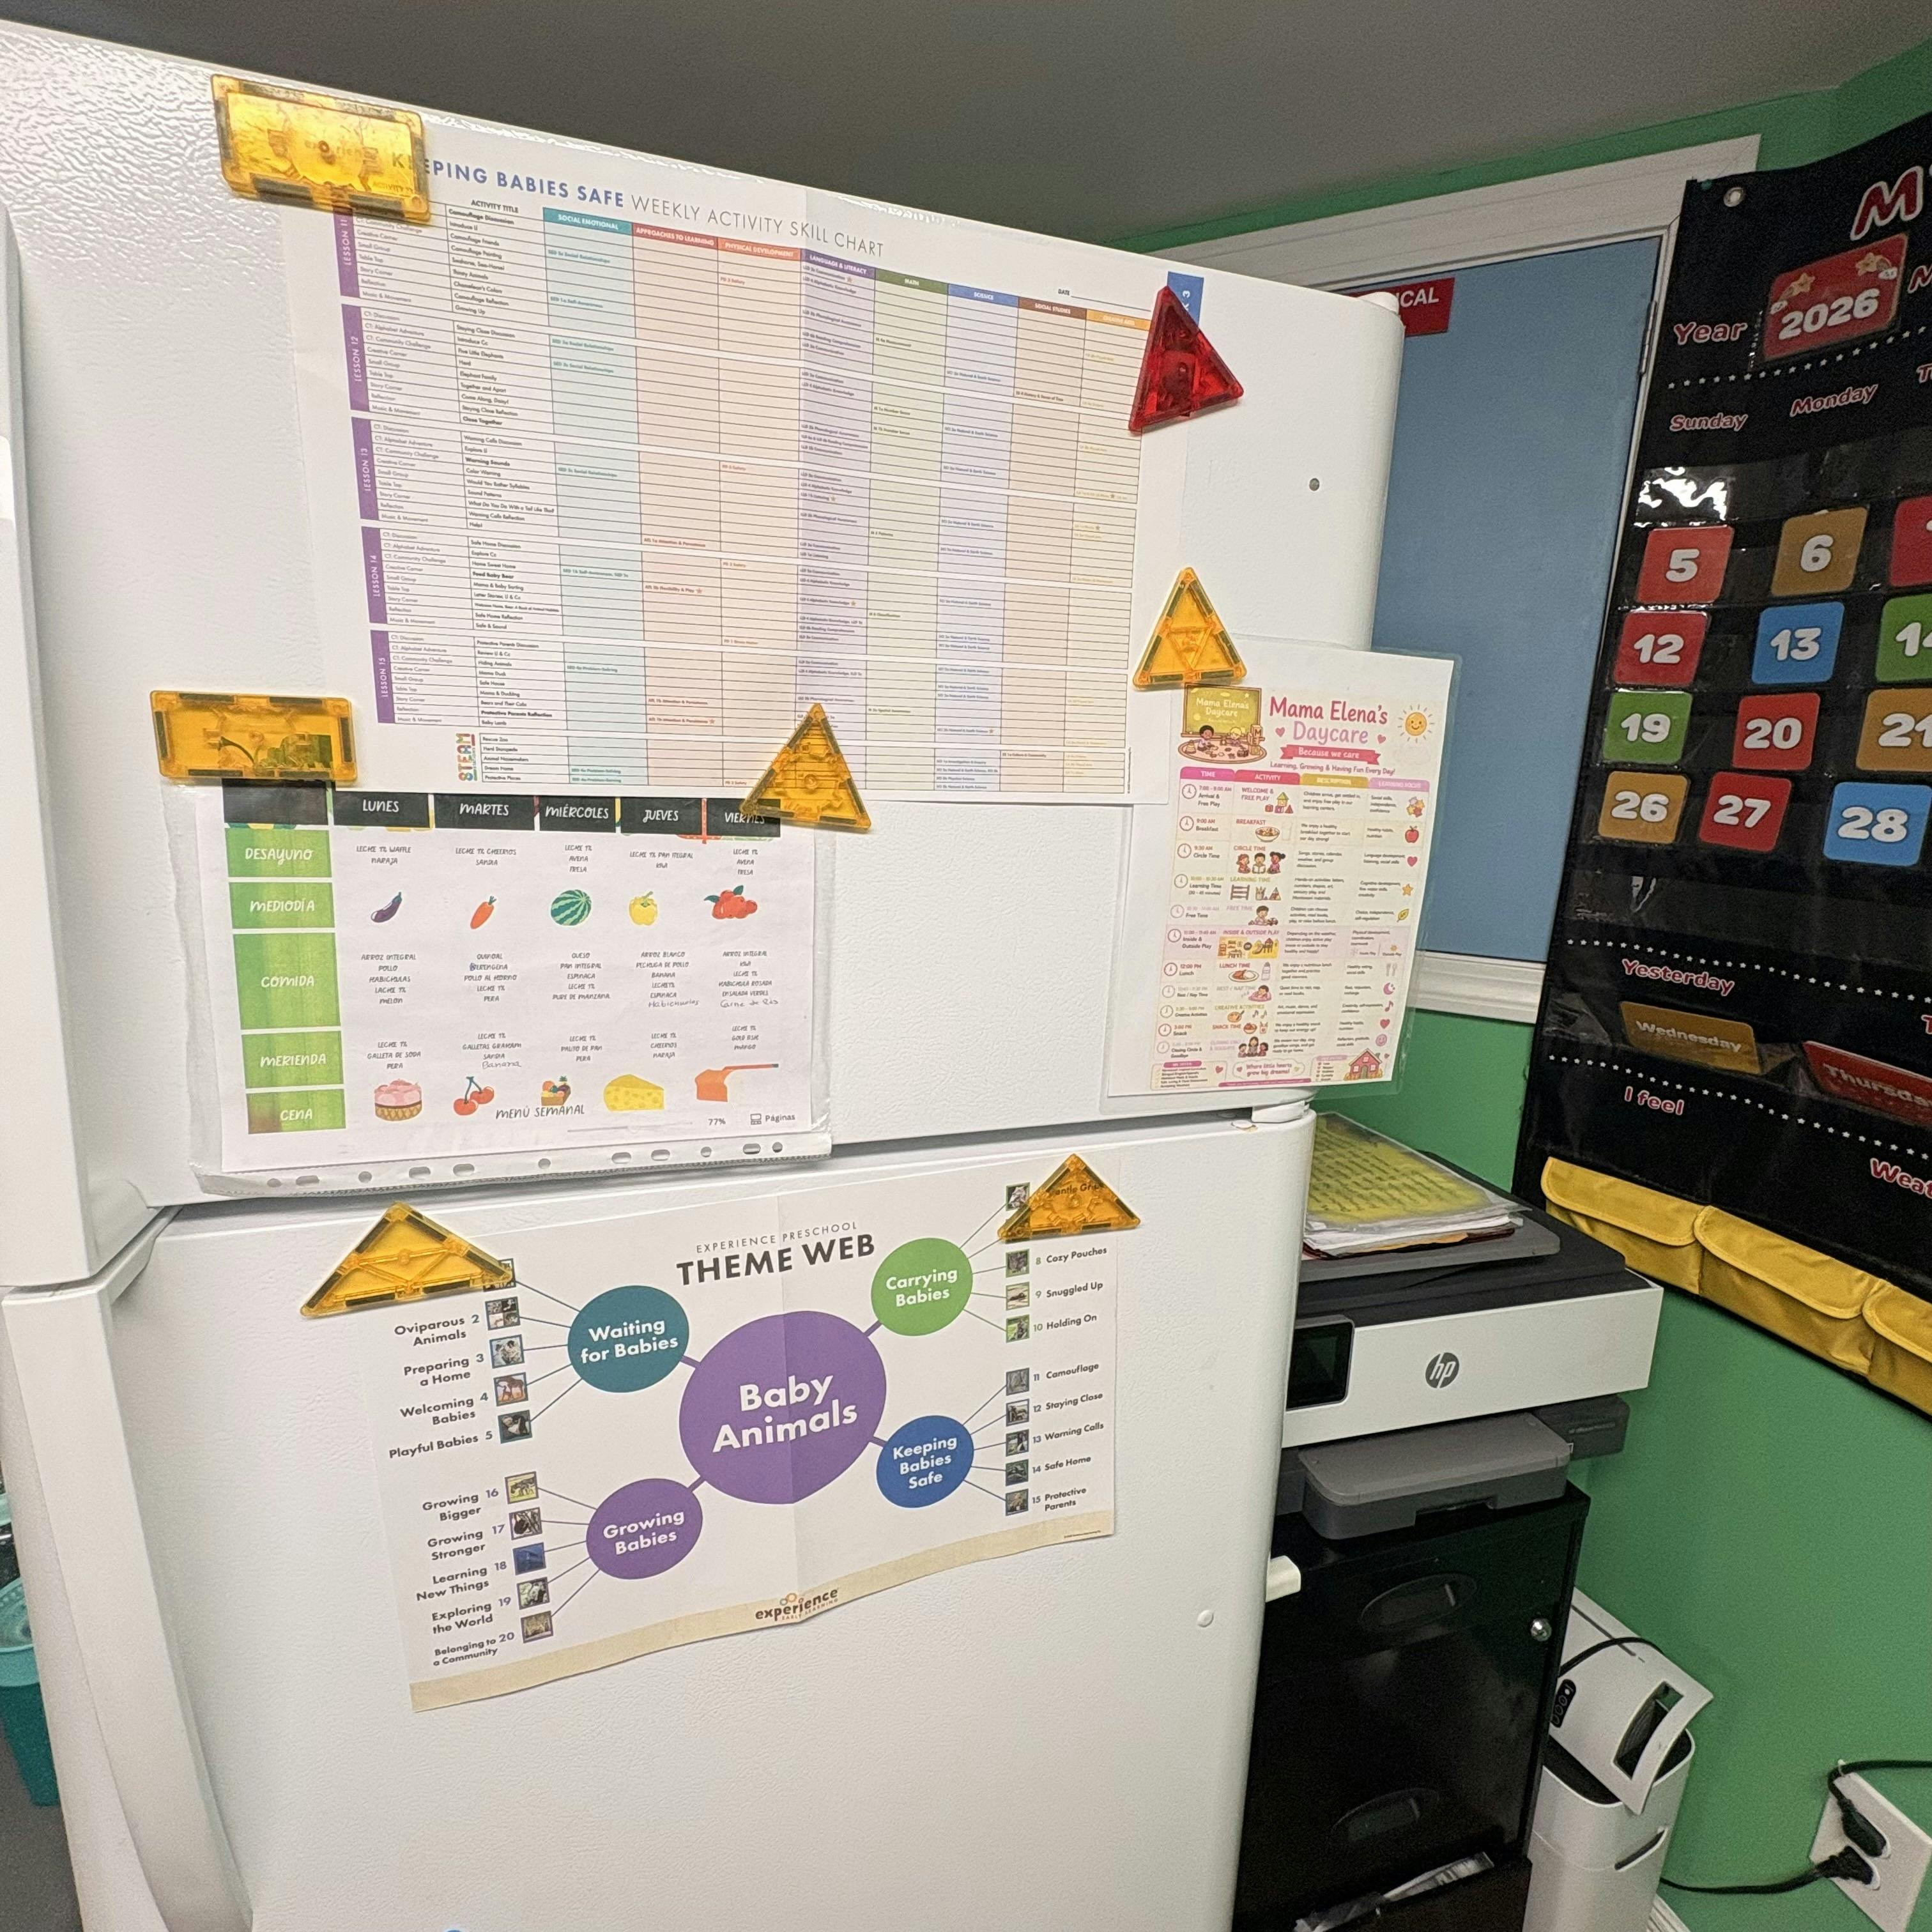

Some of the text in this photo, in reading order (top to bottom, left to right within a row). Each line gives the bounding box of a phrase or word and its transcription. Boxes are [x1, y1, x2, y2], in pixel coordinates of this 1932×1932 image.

[471, 199, 519, 213] ACTIVITY TITLE
[497, 170, 569, 198] BABIES
[576, 185, 624, 208] SAFE
[631, 194, 700, 221] WEEKLY
[707, 209, 783, 234] ACTIVITY
[790, 220, 829, 243] SKILL
[834, 232, 884, 257] CHART
[558, 215, 618, 230] SOCIAL EMOTIONAL
[904, 277, 919, 286] MATH
[1673, 288, 1880, 346] Year 2026
[351, 336, 363, 382] LESSON 12
[1669, 384, 1879, 432] Sunday Monday
[1665, 534, 1834, 583] 5 6
[1634, 633, 1685, 664] 12
[1770, 627, 1821, 661] 13
[1196, 697, 1220, 707] Mama
[1206, 707, 1238, 718] Daycare
[1269, 696, 1388, 725] Mama Elena's
[1292, 721, 1369, 746] Daycare
[1620, 712, 1671, 743] 19
[1743, 717, 1802, 749] 20
[1298, 747, 1329, 757] Because
[1300, 762, 1324, 771] Growing
[1331, 765, 1351, 774] Having
[1365, 767, 1381, 775] Every
[1383, 768, 1395, 776] Day!
[362, 799, 400, 812] LUNES
[459, 802, 509, 816] MARTES
[545, 804, 609, 819] MIÉRCOLES
[642, 809, 679, 823] JUEVES
[724, 812, 765, 824] VIERNES
[1611, 790, 1908, 843] 26 27 28
[245, 848, 313, 864] DESAYUNO
[250, 899, 315, 914] MEDIODÍA
[261, 976, 315, 988] COMIDA
[1622, 958, 1735, 996] Yesterday
[1636, 1020, 1742, 1053] Wednesday
[260, 1053, 326, 1068] MERIENDA
[1623, 1086, 1685, 1116] I feel
[280, 1108, 312, 1121] CENA
[496, 1104, 585, 1120] MENÚ SEMANAL
[708, 1117, 726, 1126] 77%
[765, 1114, 795, 1124] Páginas
[696, 1222, 857, 1254] EXPERIENCE PRESCHOOL
[676, 1234, 875, 1285] THEME WEB
[1036, 1247, 1107, 1265] 8 Cozy Pouches
[885, 1268, 958, 1291] Carrying
[896, 1287, 951, 1307] Babies
[1036, 1282, 1103, 1299] 9 Snuggled Up
[394, 1314, 480, 1335] Oviparous 2
[588, 1319, 666, 1342] Waiting
[1033, 1314, 1097, 1332] 10 Holding On
[413, 1328, 466, 1347] Animals
[580, 1336, 678, 1364] for Babies
[403, 1353, 484, 1377] Preparing 3
[1033, 1362, 1100, 1382] 11 Camouflage
[1427, 1353, 1457, 1388] hp
[420, 1369, 471, 1387] a Home
[740, 1374, 834, 1412] Baby
[1033, 1392, 1103, 1413] 12 Staying Close
[399, 1392, 489, 1418] Welcoming 4
[432, 1409, 476, 1426] Babies
[712, 1399, 858, 1453] Animals
[1032, 1422, 1104, 1444] 13 Warning Calls
[388, 1430, 493, 1459] Playful Babies 5
[893, 1436, 958, 1460] Keeping
[899, 1454, 951, 1475] Babies
[1032, 1455, 1091, 1474] 14 Safe Home
[908, 1473, 943, 1490] Safe
[422, 1487, 499, 1512] Growing 16
[1032, 1487, 1087, 1505] 15 Protective
[1045, 1499, 1077, 1512] Parents
[439, 1505, 482, 1523] Bigger
[602, 1510, 686, 1540] Growing
[427, 1524, 505, 1549] Growing 17
[614, 1530, 678, 1556] Babies
[431, 1543, 486, 1561] Stronger
[432, 1561, 507, 1586] Learning 18
[416, 1579, 490, 1602] New Things
[431, 1597, 512, 1621] Exploring 19
[755, 1588, 839, 1621] experience
[804, 1598, 839, 1616] LEARNING
[433, 1614, 494, 1635] the World
[434, 1632, 515, 1657] Belonging to 20
[441, 1647, 498, 1664] Community
